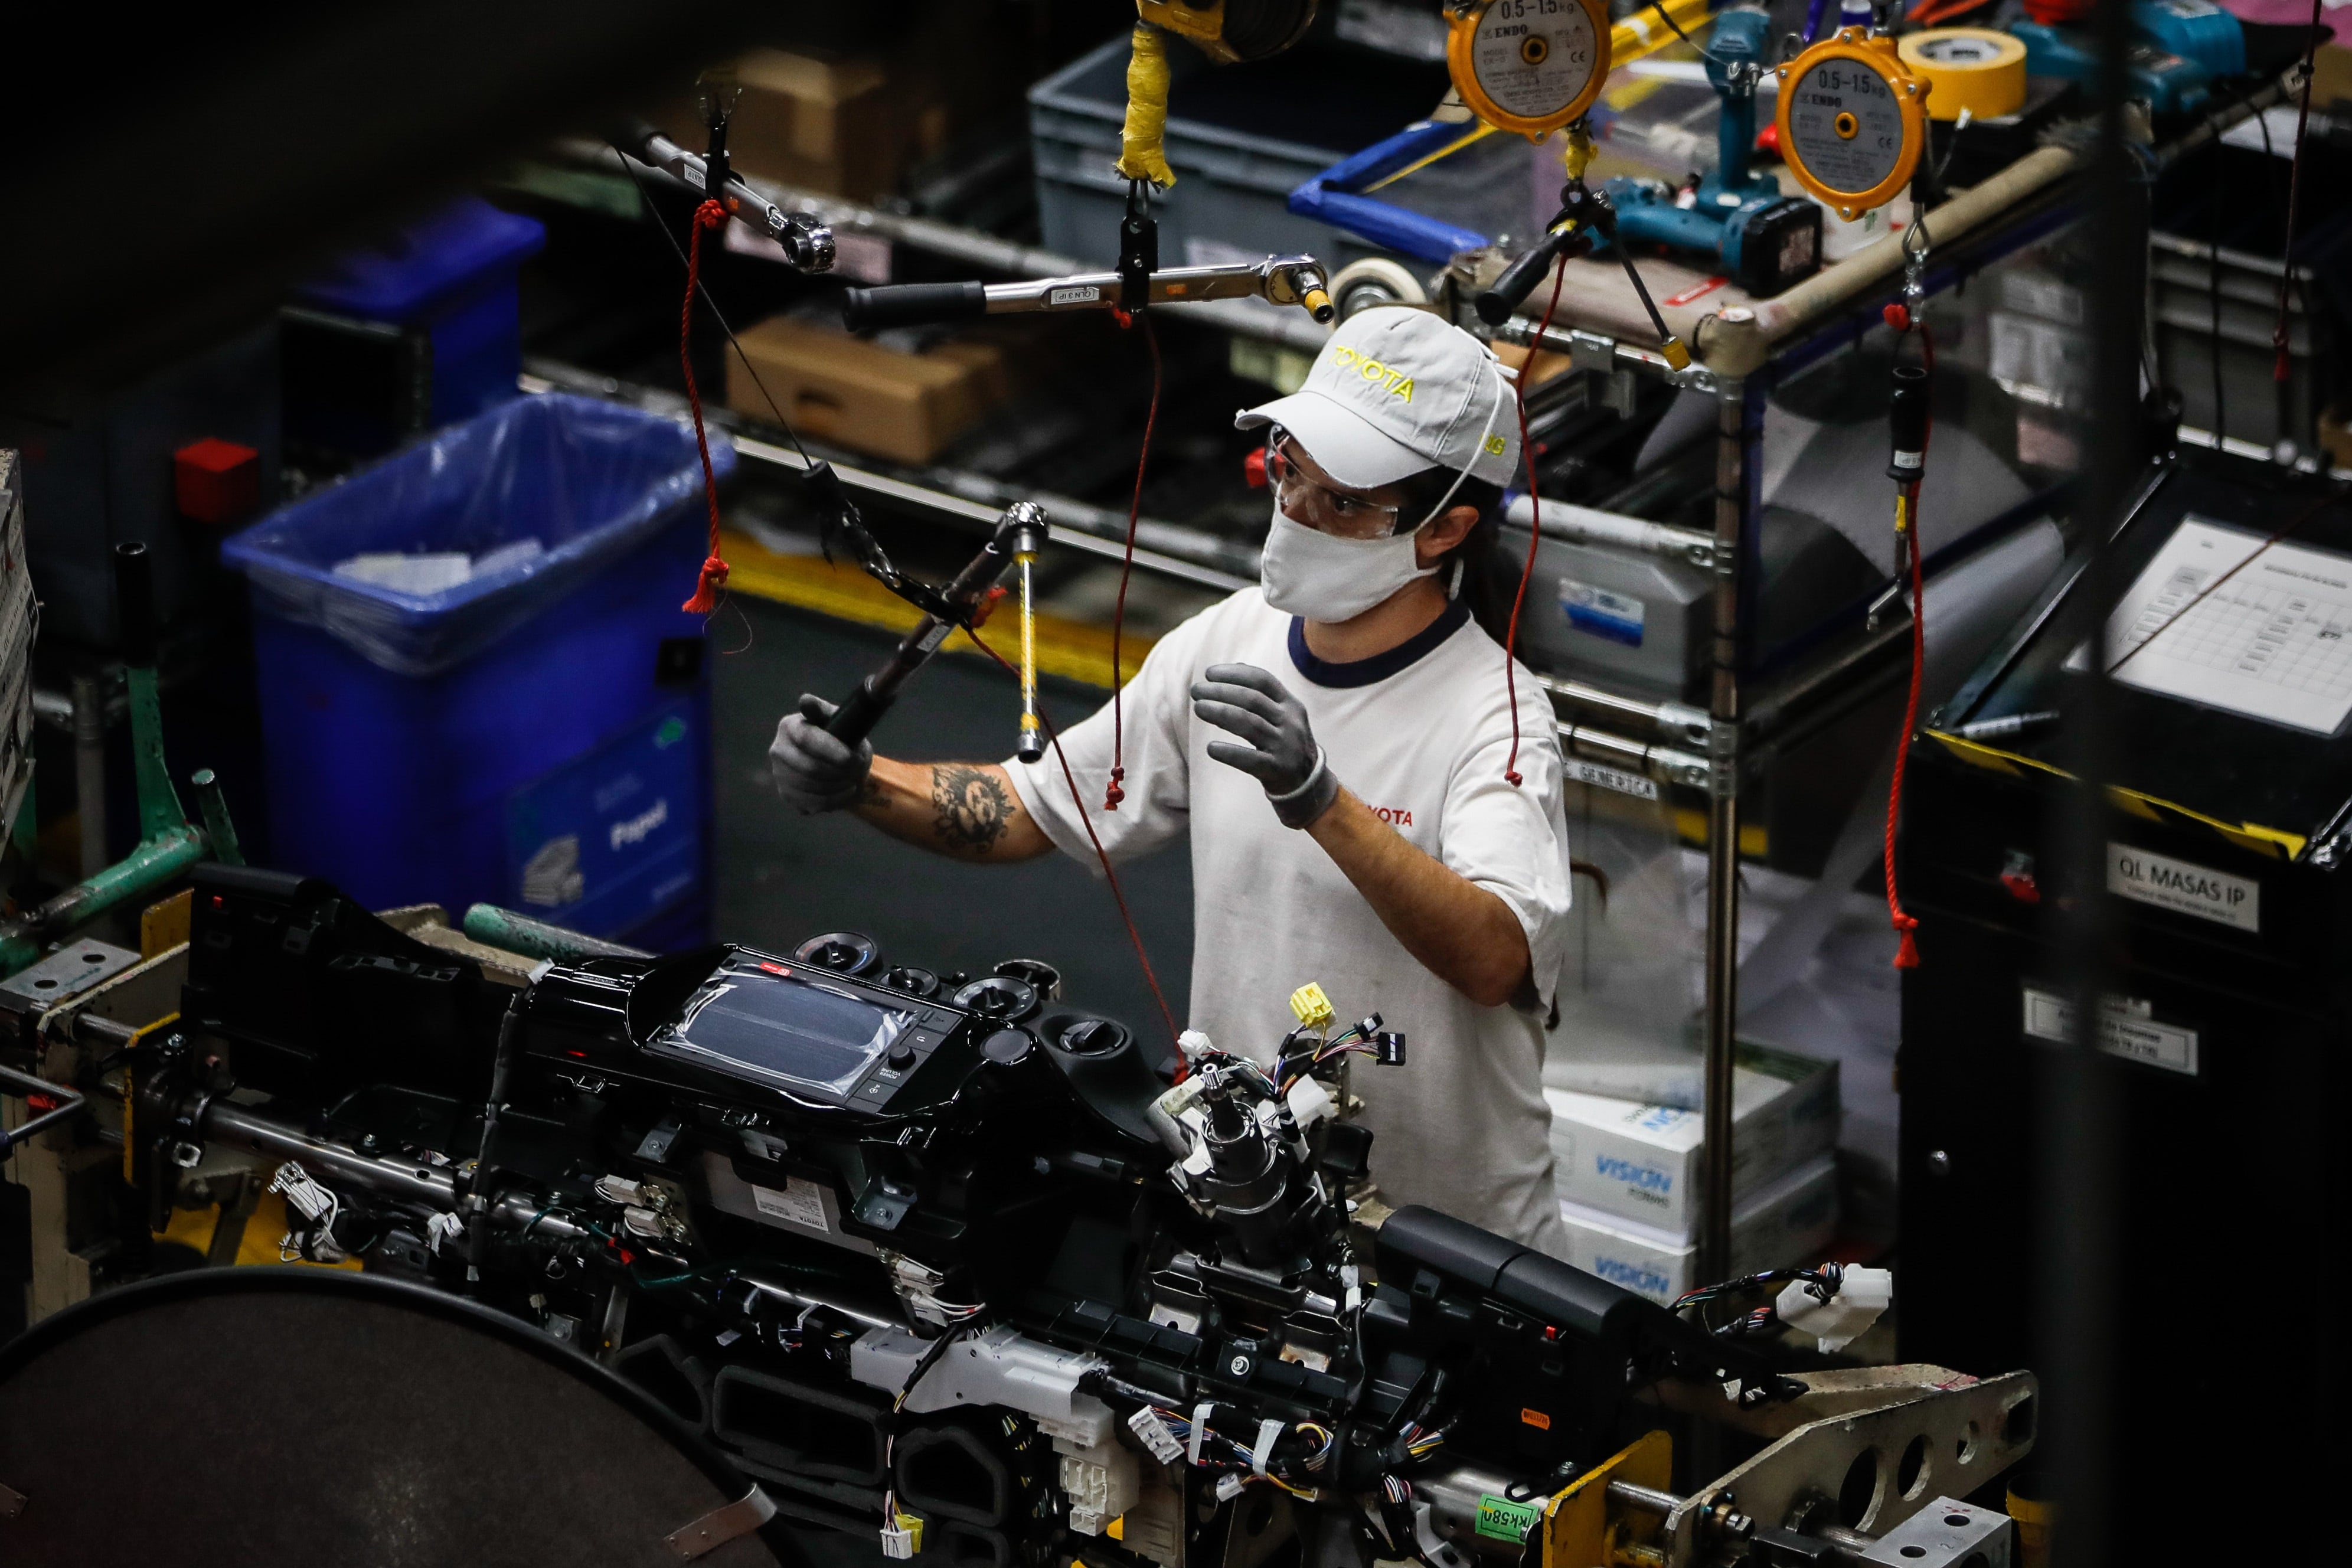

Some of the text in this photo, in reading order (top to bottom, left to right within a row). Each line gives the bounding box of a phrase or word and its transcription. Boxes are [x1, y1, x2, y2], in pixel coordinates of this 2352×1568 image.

[1495, 24, 1528, 38] ENDO
[1812, 94, 1842, 108] ENDO
[1329, 345, 1415, 404] TOYOTA
[2120, 855, 2144, 882] QL
[2151, 865, 2220, 901] MASAS
[2227, 886, 2245, 906] IP
[1596, 1153, 1672, 1193] VISION
[799, 1216, 824, 1228] TOYOTA
[1595, 1256, 1670, 1294] VISION
